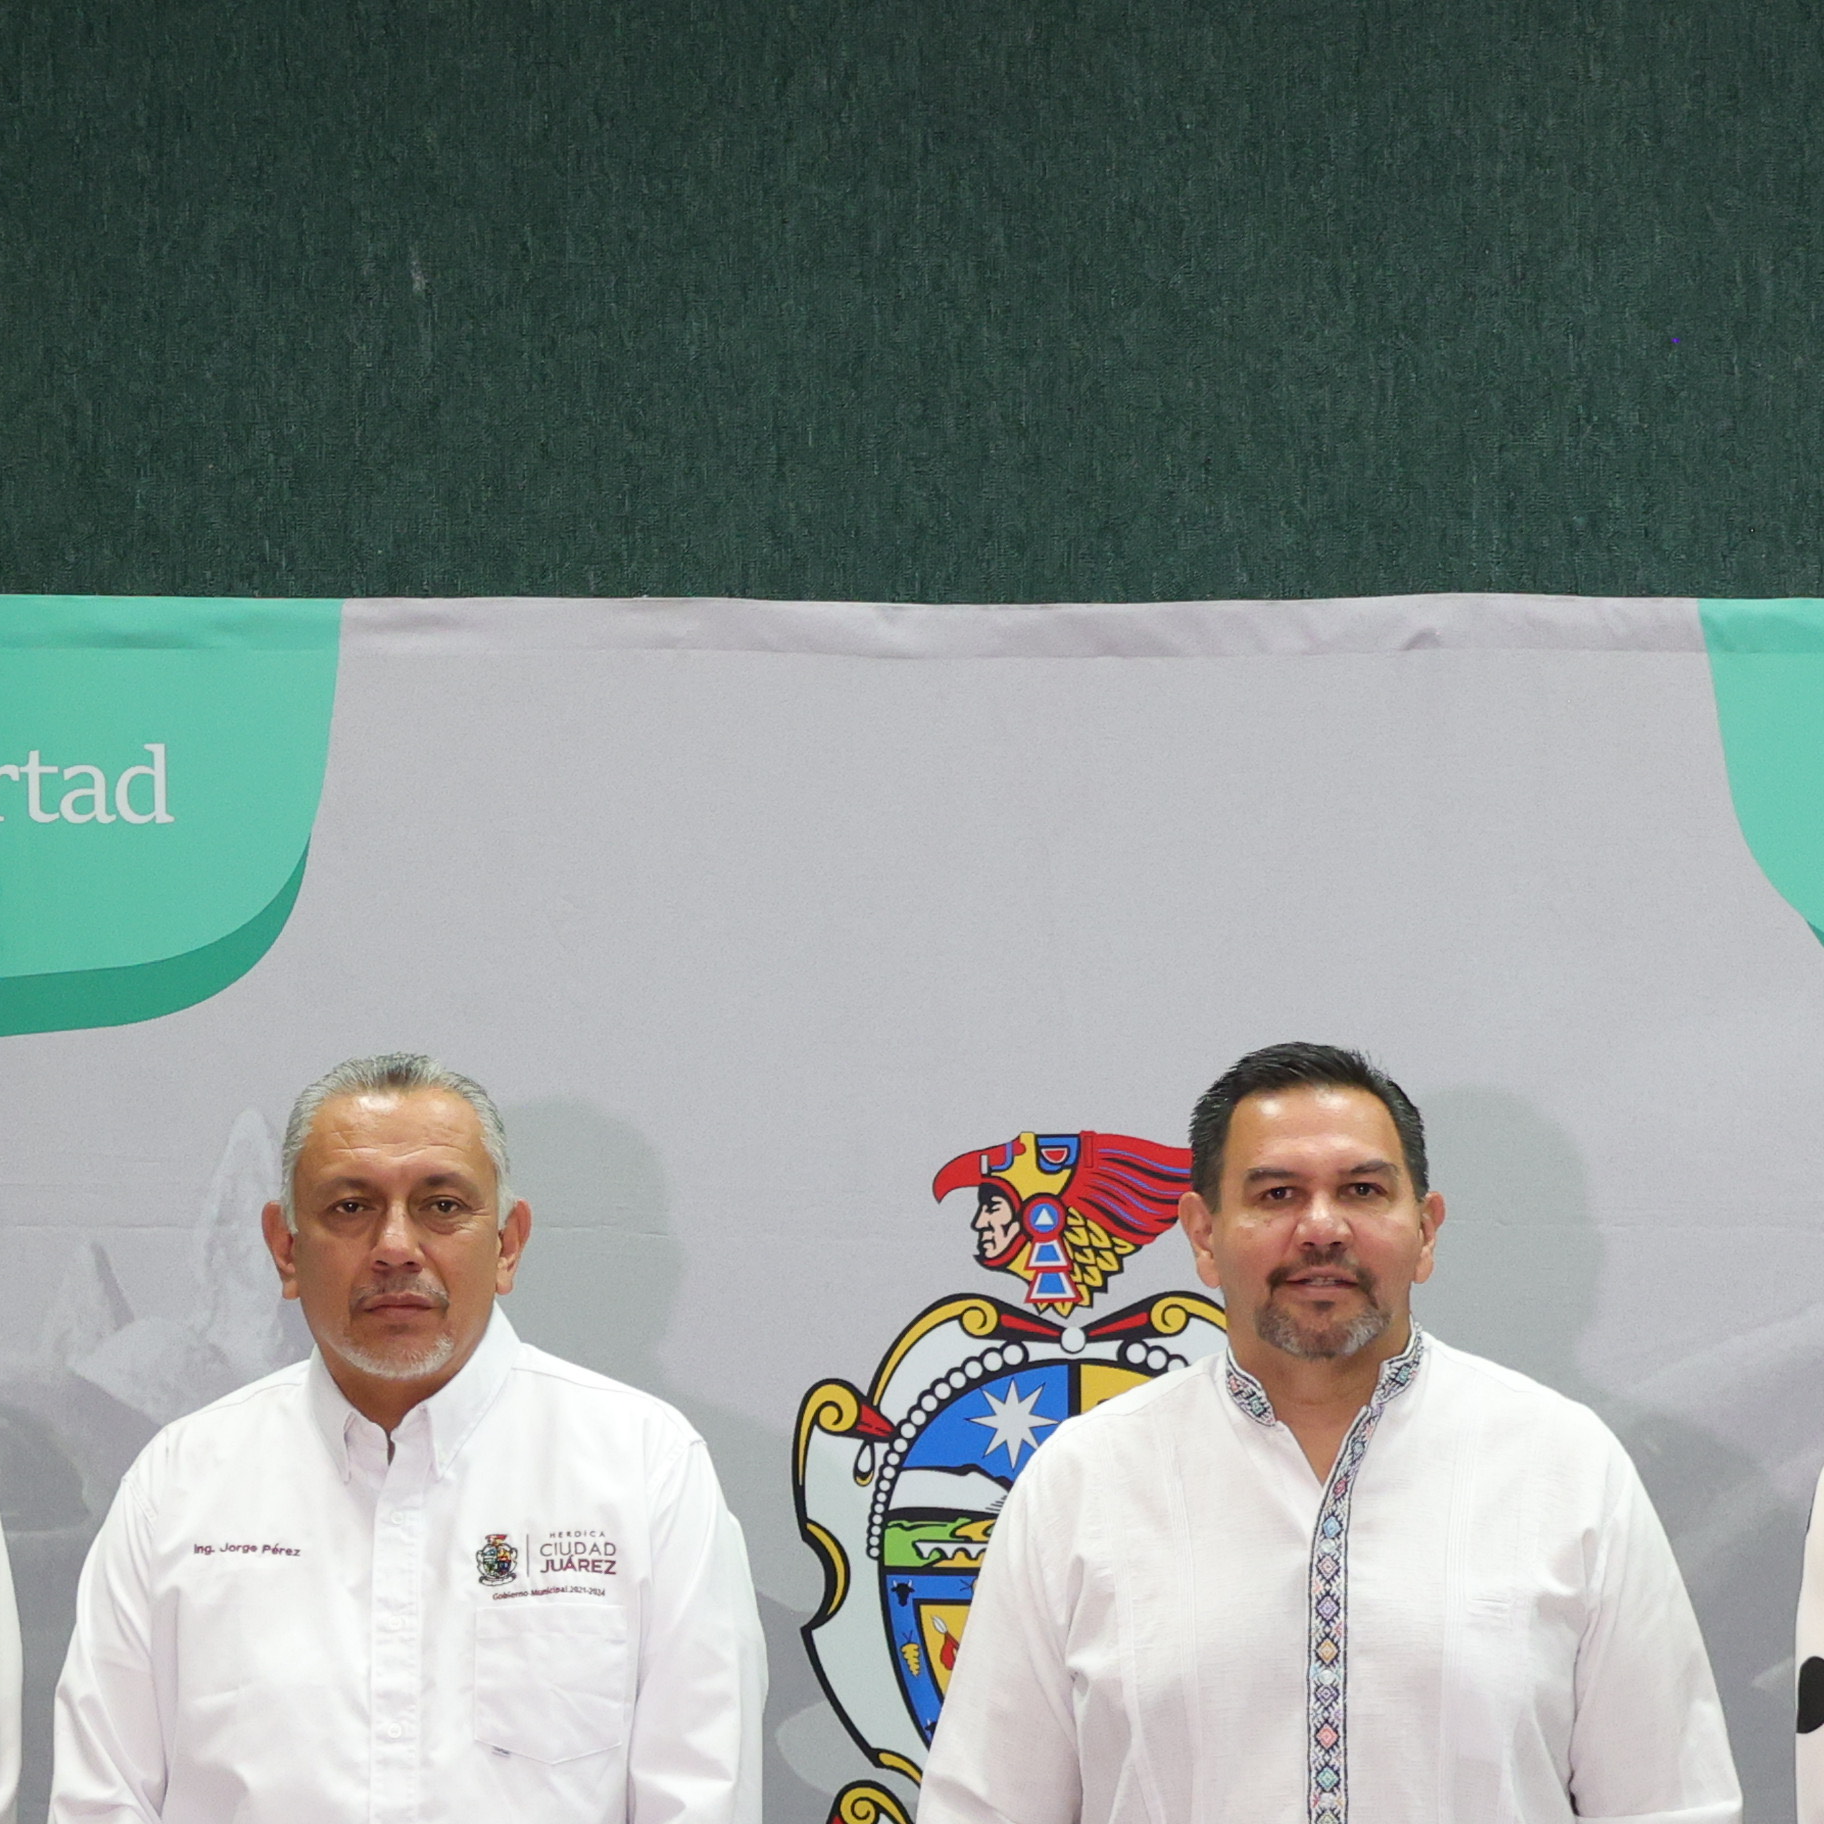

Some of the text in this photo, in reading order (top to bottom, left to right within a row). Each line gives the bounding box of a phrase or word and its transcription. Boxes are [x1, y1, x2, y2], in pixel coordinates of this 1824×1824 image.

[219, 1542, 258, 1554] Jorge
[261, 1543, 301, 1557] Pérez
[539, 1541, 617, 1558] CIUDAD
[540, 1555, 617, 1576] JUÁREZ
